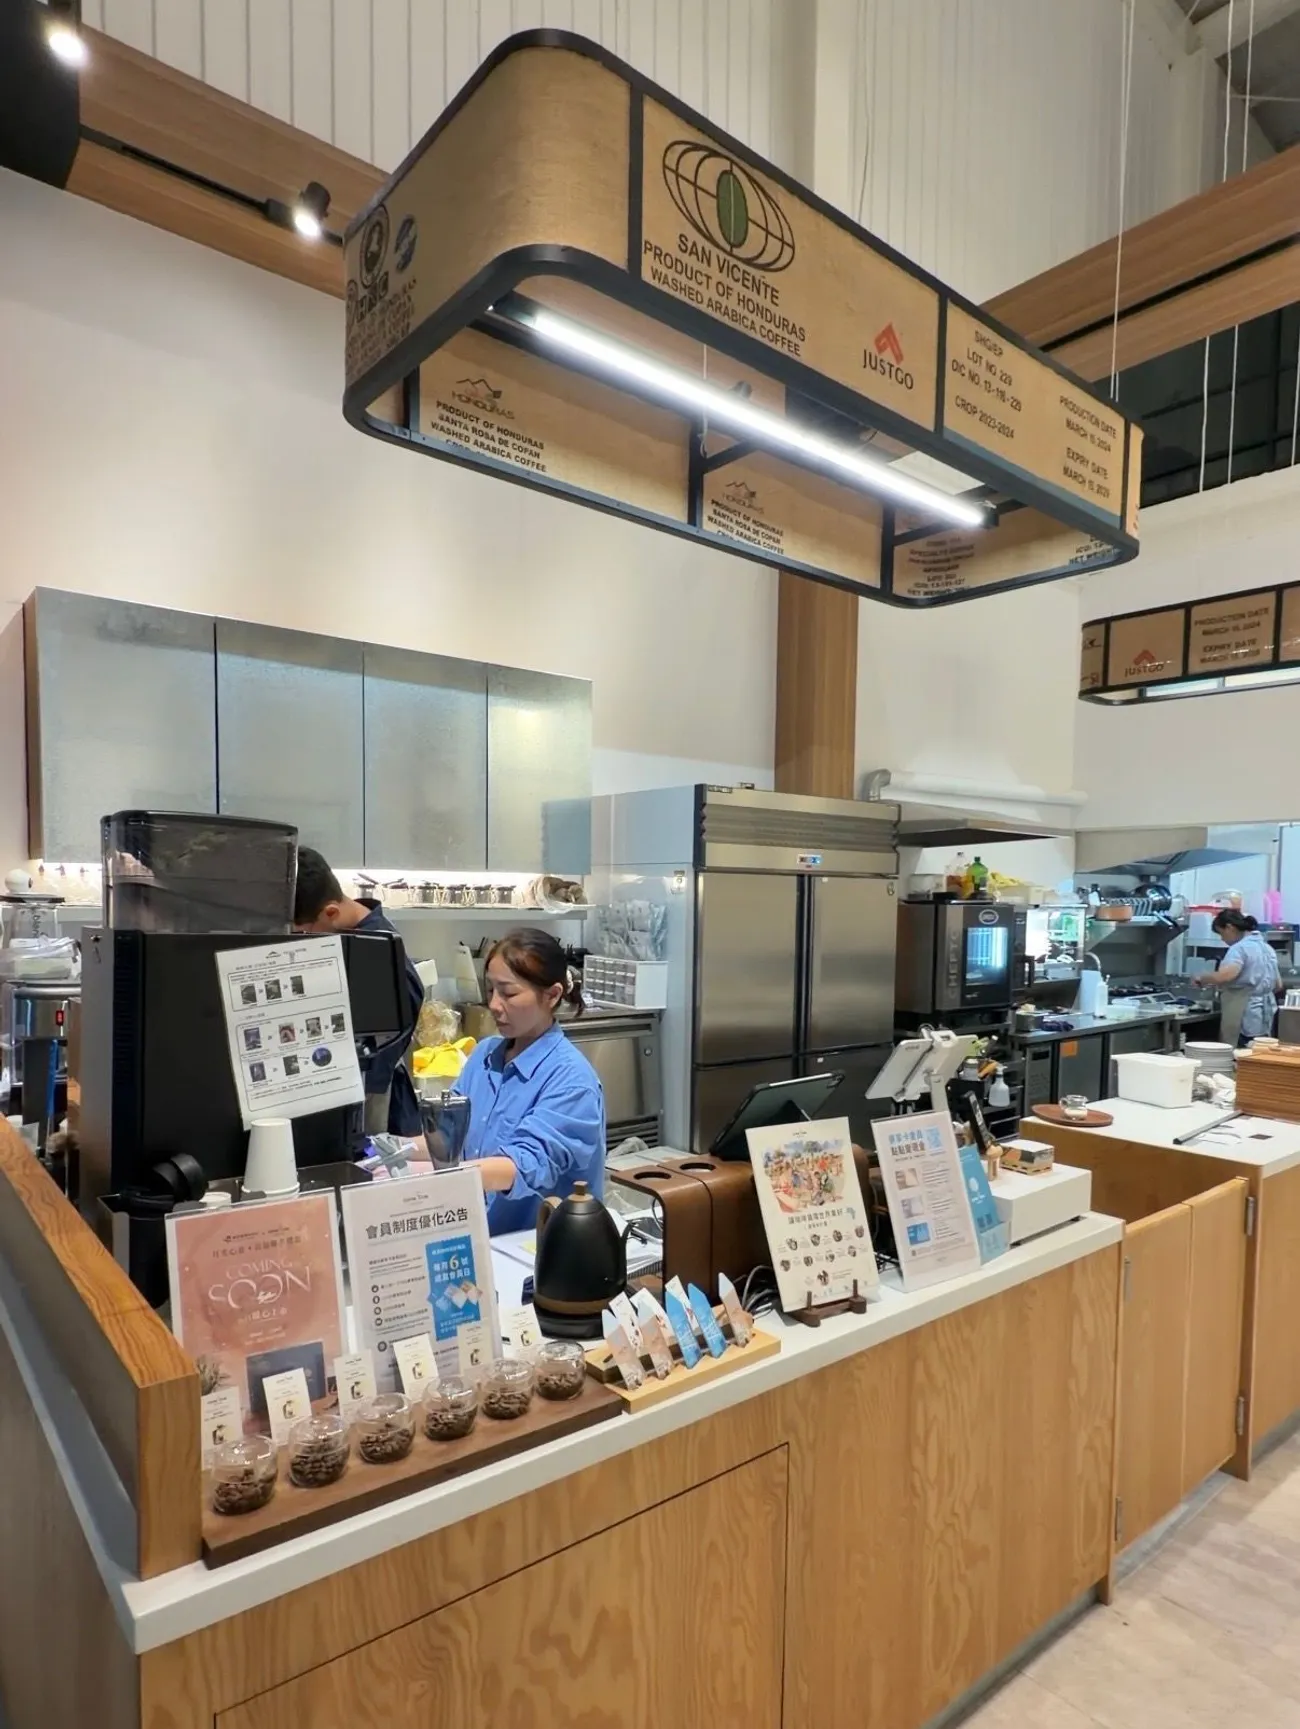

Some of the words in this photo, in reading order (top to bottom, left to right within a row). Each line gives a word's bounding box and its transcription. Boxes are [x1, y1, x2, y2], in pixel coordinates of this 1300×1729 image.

[678, 233, 712, 268] SAN
[716, 252, 780, 307] VICENTE
[643, 240, 713, 291] PRODUCT
[715, 280, 734, 300] OF
[737, 290, 806, 343] HONDURAS
[650, 265, 704, 306] WASHED
[707, 295, 757, 334] ARABICA
[759, 325, 801, 357] COFFEE
[863, 349, 914, 390] JUSTGO
[967, 347, 983, 367] LOT
[954, 395, 978, 416] CROP
[1060, 395, 1100, 428] PRODUCTION
[1101, 420, 1117, 439] DATE
[436, 400, 480, 424] PRODUCT
[483, 420, 494, 430] OF
[497, 426, 544, 450] HONDURAS
[438, 412, 469, 432] SANTA
[472, 427, 495, 443] ROSA
[498, 437, 509, 448] DE
[1066, 418, 1088, 439] MARCH
[431, 421, 470, 444] WASHED
[473, 439, 511, 460] ARABICA
[514, 455, 547, 473] COFFEE
[1066, 447, 1089, 468] EXPIRY
[1091, 462, 1108, 480] DATE
[1063, 464, 1086, 486] MARCH
[707, 515, 735, 533] WASHED
[735, 530, 761, 546] ARABICA
[762, 541, 784, 555] COFFEE
[711, 499, 741, 518] PRODUCT
[742, 514, 751, 522] OF
[752, 518, 783, 538] HONDURAS
[713, 508, 734, 522] SANTA
[735, 519, 751, 532] ROSA
[1247, 607, 1269, 618] DATE
[1235, 638, 1257, 649] DATE
[1124, 664, 1164, 677] JUSTGO
[366, 1207, 468, 1240] 會員制度優化公告
[226, 1258, 294, 1280] COMING
[208, 1266, 312, 1310] SOON
